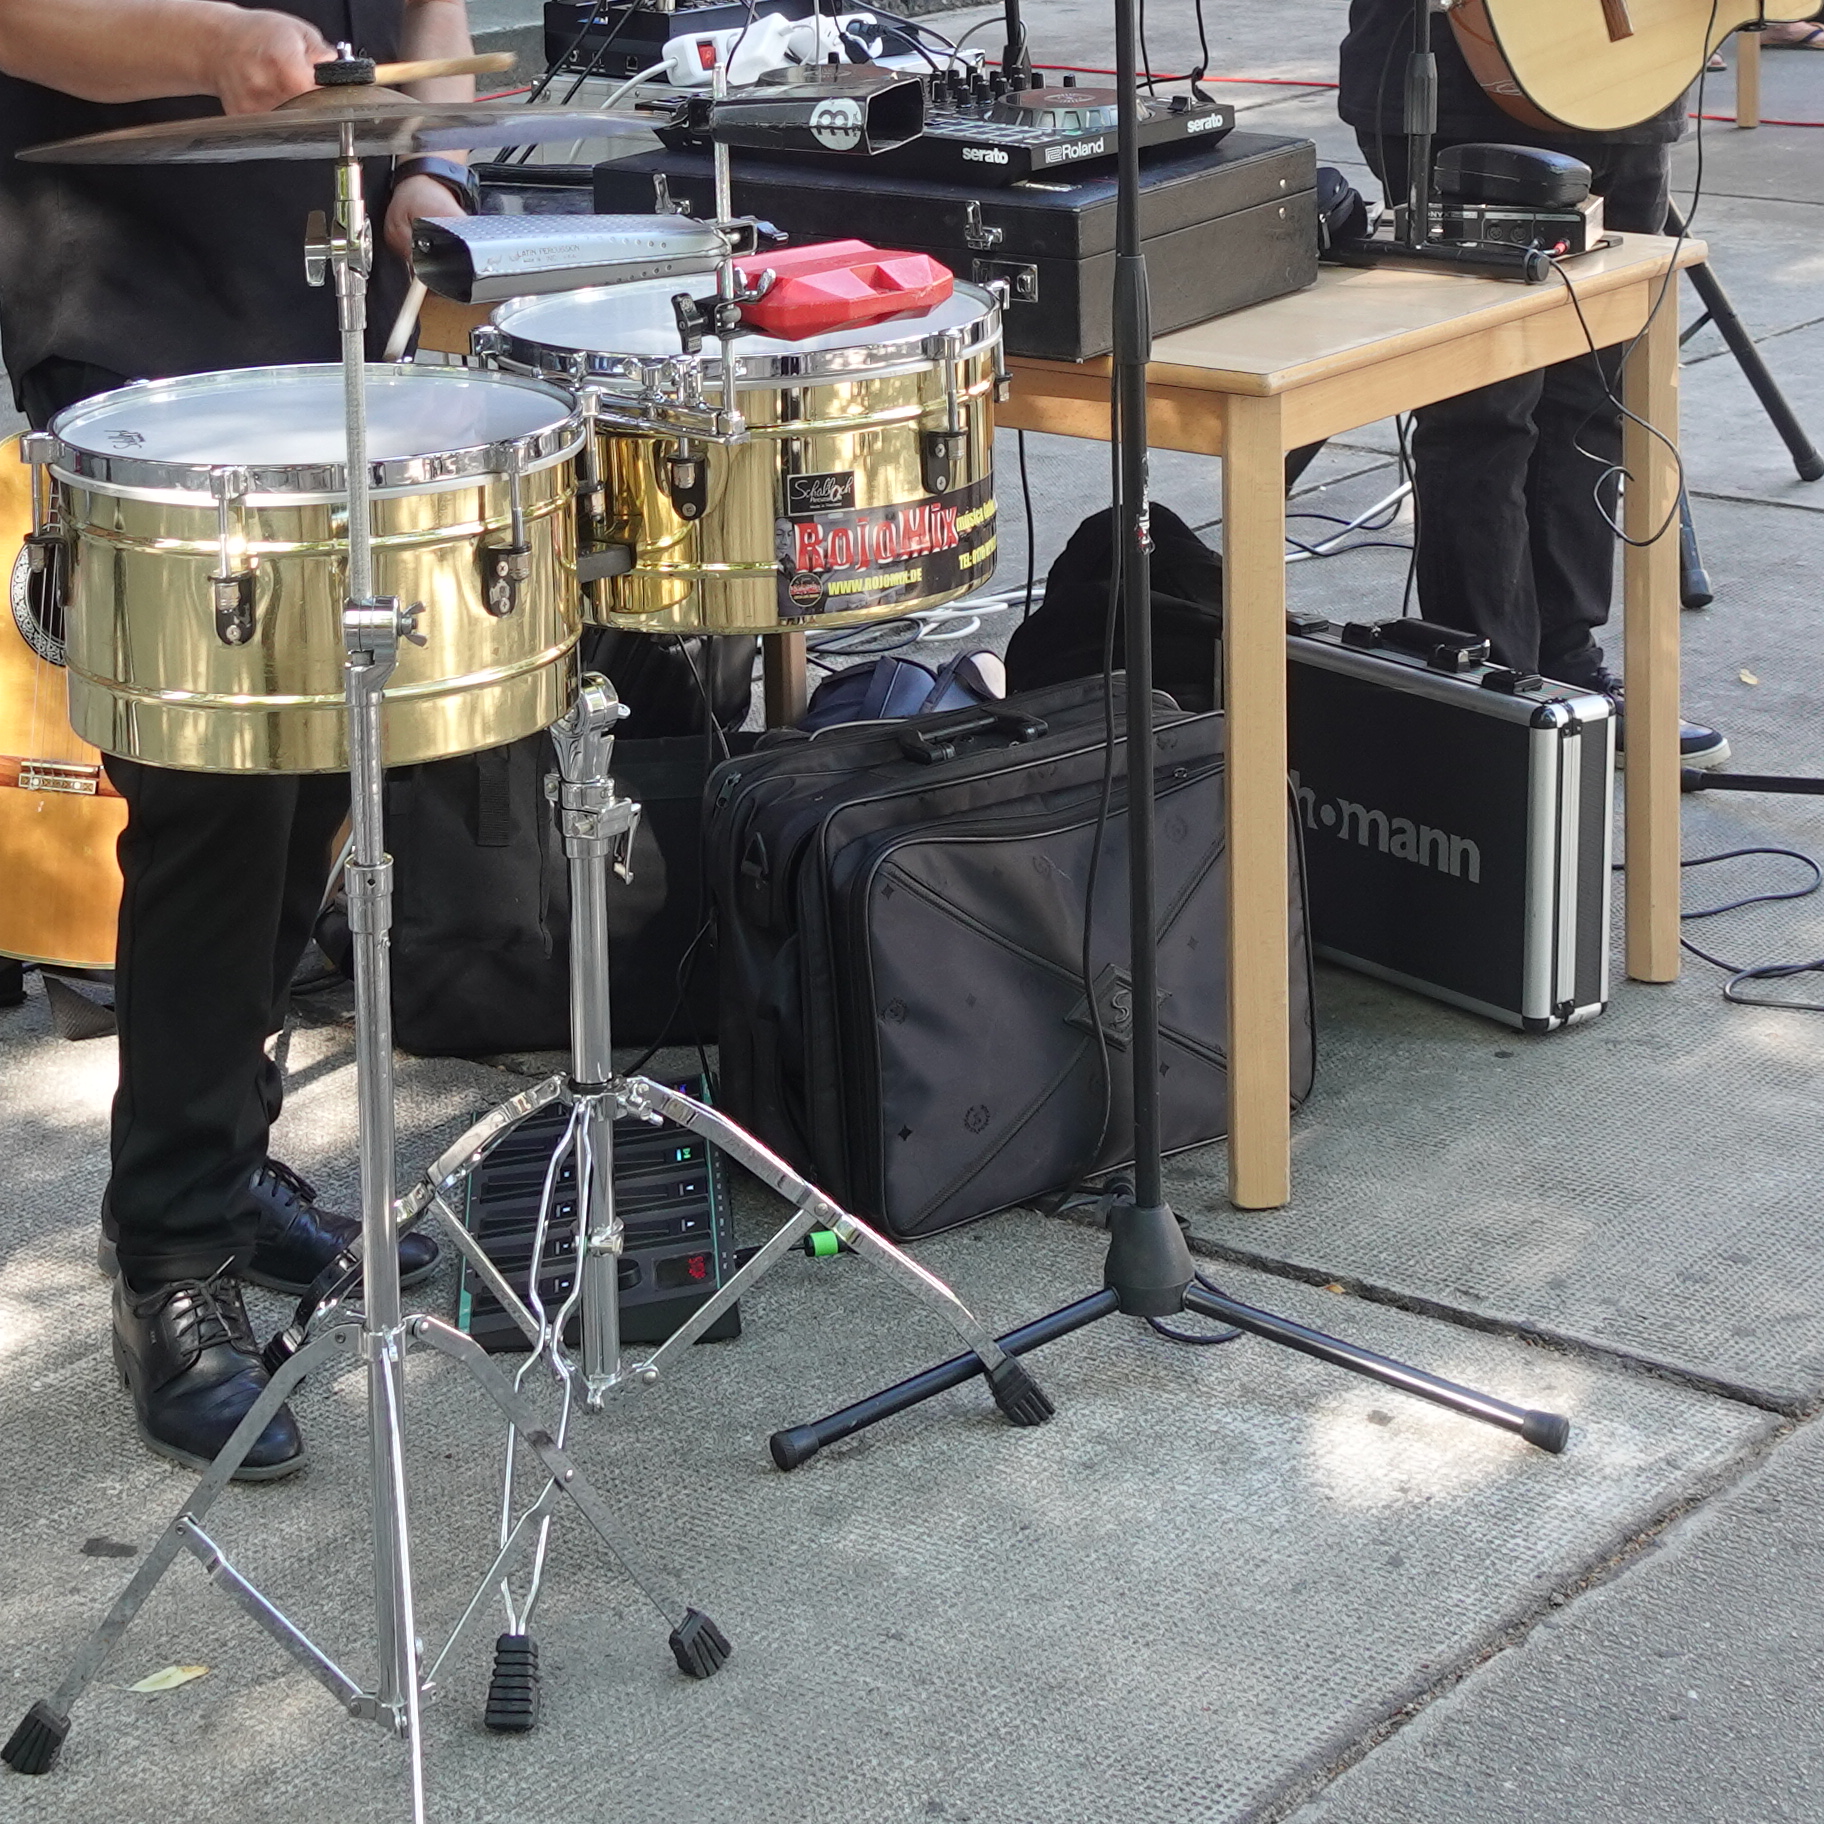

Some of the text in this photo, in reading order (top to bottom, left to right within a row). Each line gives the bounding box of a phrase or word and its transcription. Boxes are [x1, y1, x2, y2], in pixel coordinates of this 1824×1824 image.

[1187, 112, 1223, 133] serato
[962, 147, 1009, 164] serato
[1062, 137, 1104, 160] Roland
[828, 567, 923, 596] WWW.ROJOMIX.DE
[1290, 768, 1480, 884] homann
